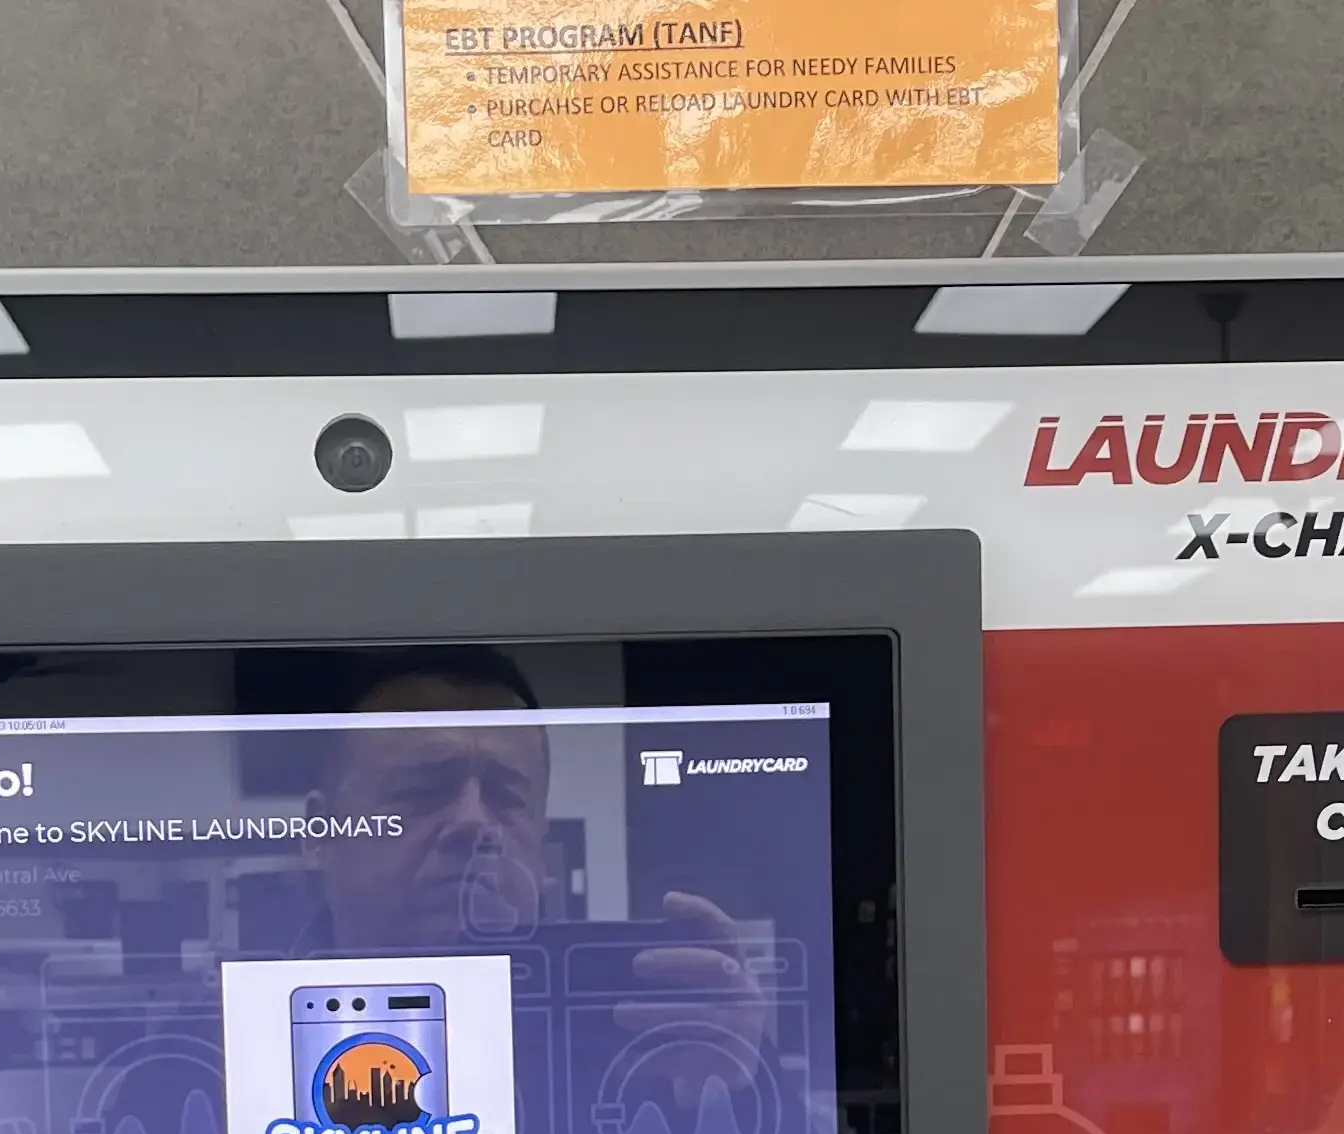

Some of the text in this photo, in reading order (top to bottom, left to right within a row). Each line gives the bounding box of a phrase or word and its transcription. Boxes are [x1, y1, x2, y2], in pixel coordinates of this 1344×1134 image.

[446, 19, 743, 50] EBT PROGRAM (TANF)
[487, 55, 956, 84] TEMPORARY ASSISTANCE FOR NEEDY FAMILIES
[487, 86, 984, 117] PURCAHSE OR RELOAD LAUNDRY CARD WITH EBT
[487, 129, 543, 148] CARD
[49, 719, 66, 730] AM
[686, 757, 808, 775] LAUNDRYCARD
[36, 822, 64, 843] to
[70, 819, 183, 843] SKYLINE
[192, 815, 404, 841] LAUNDROMATS
[43, 866, 82, 883] Ave
